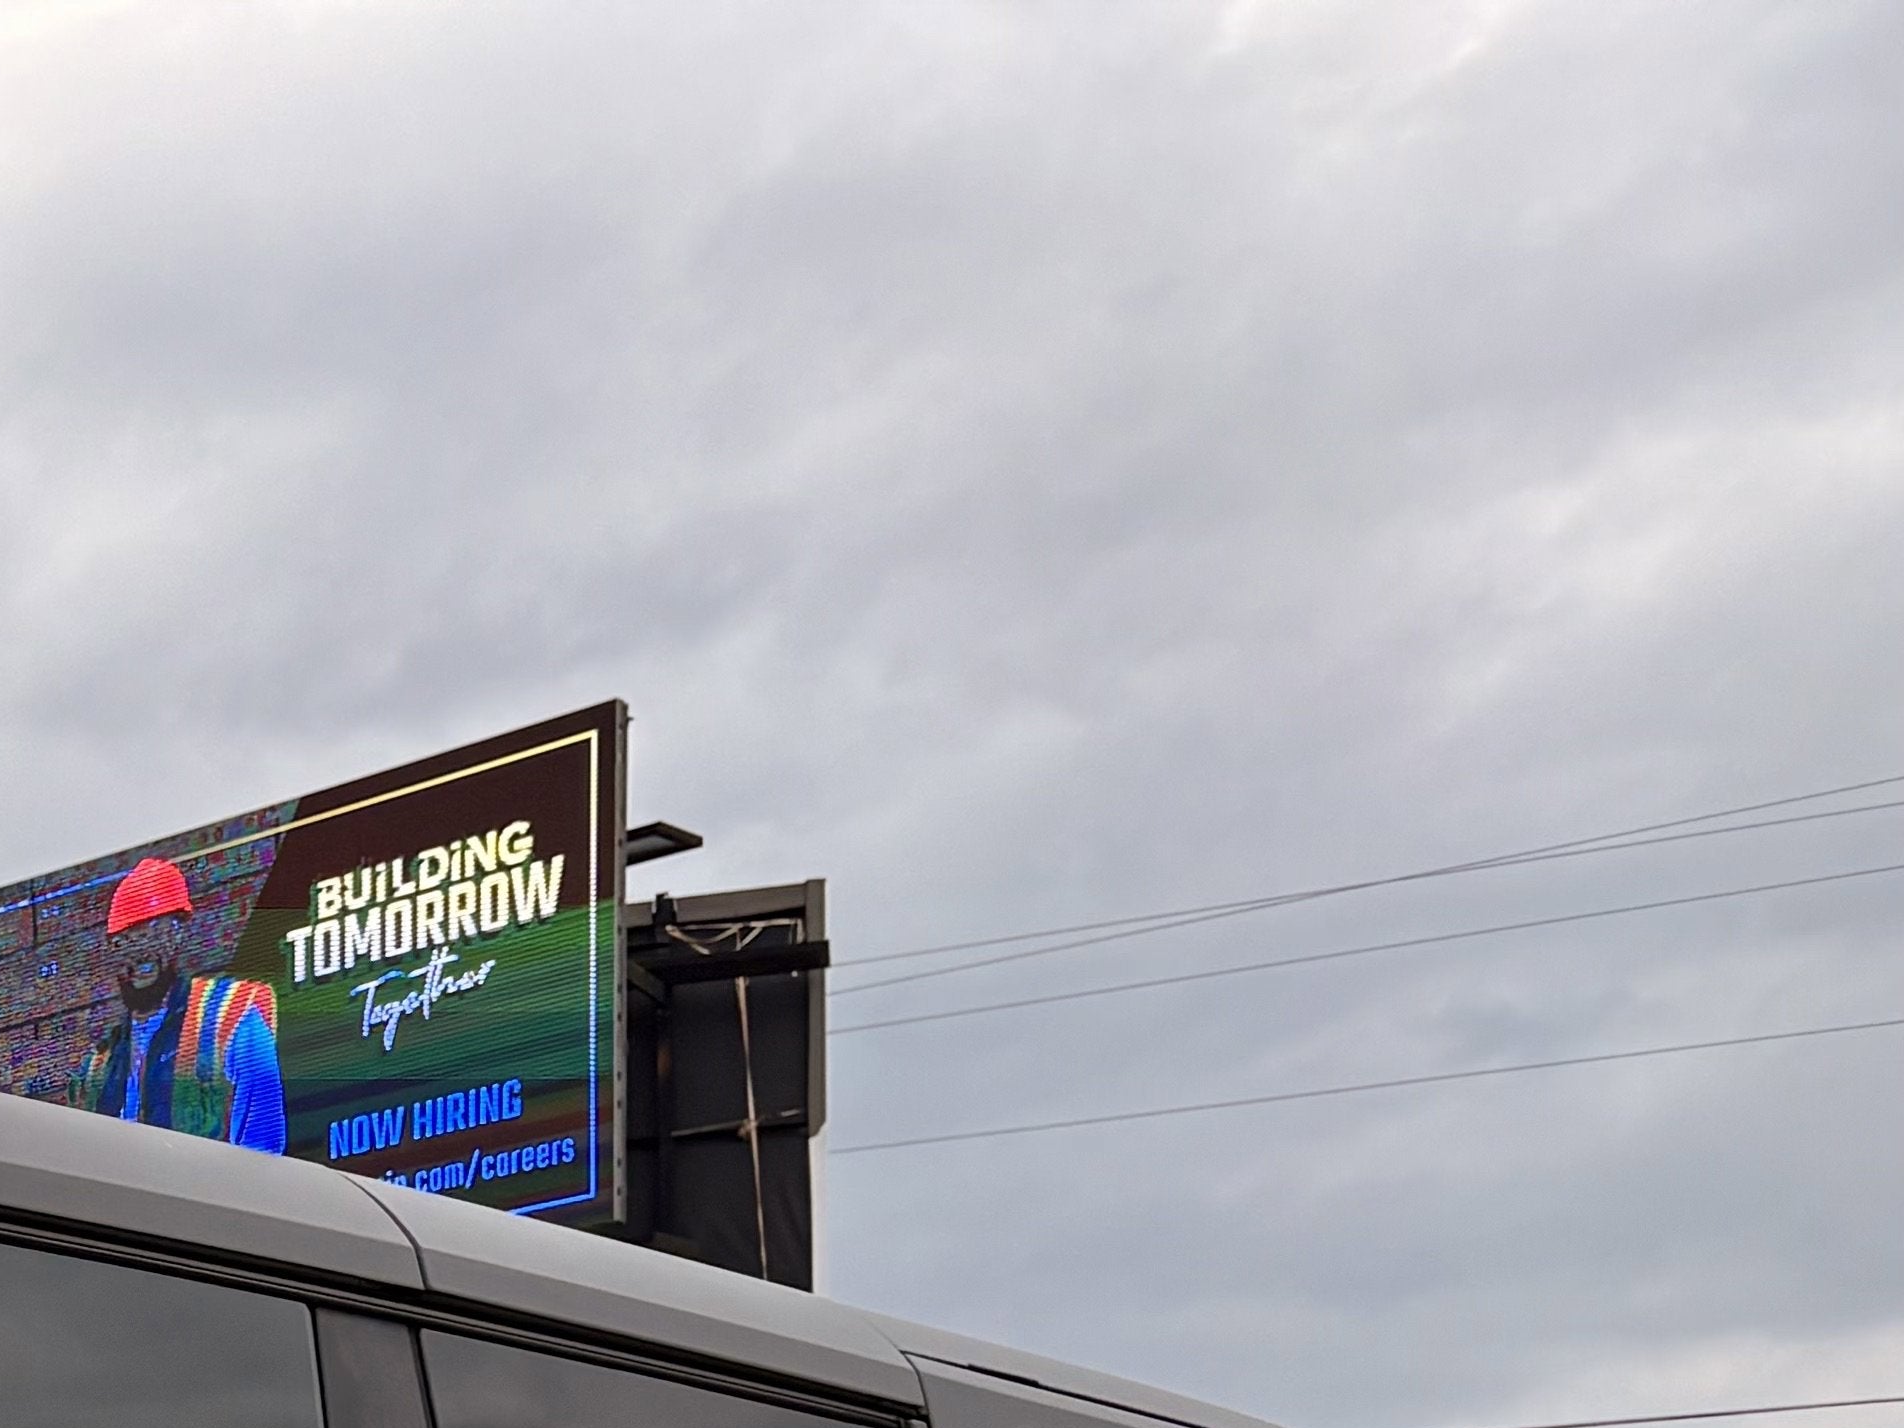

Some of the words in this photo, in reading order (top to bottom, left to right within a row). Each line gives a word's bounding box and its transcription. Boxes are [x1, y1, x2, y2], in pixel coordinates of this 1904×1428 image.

[286, 853, 566, 984] TOMORROW
[350, 945, 496, 1050] Together
[328, 1105, 405, 1160] NOW
[412, 1078, 523, 1141] HIRING
